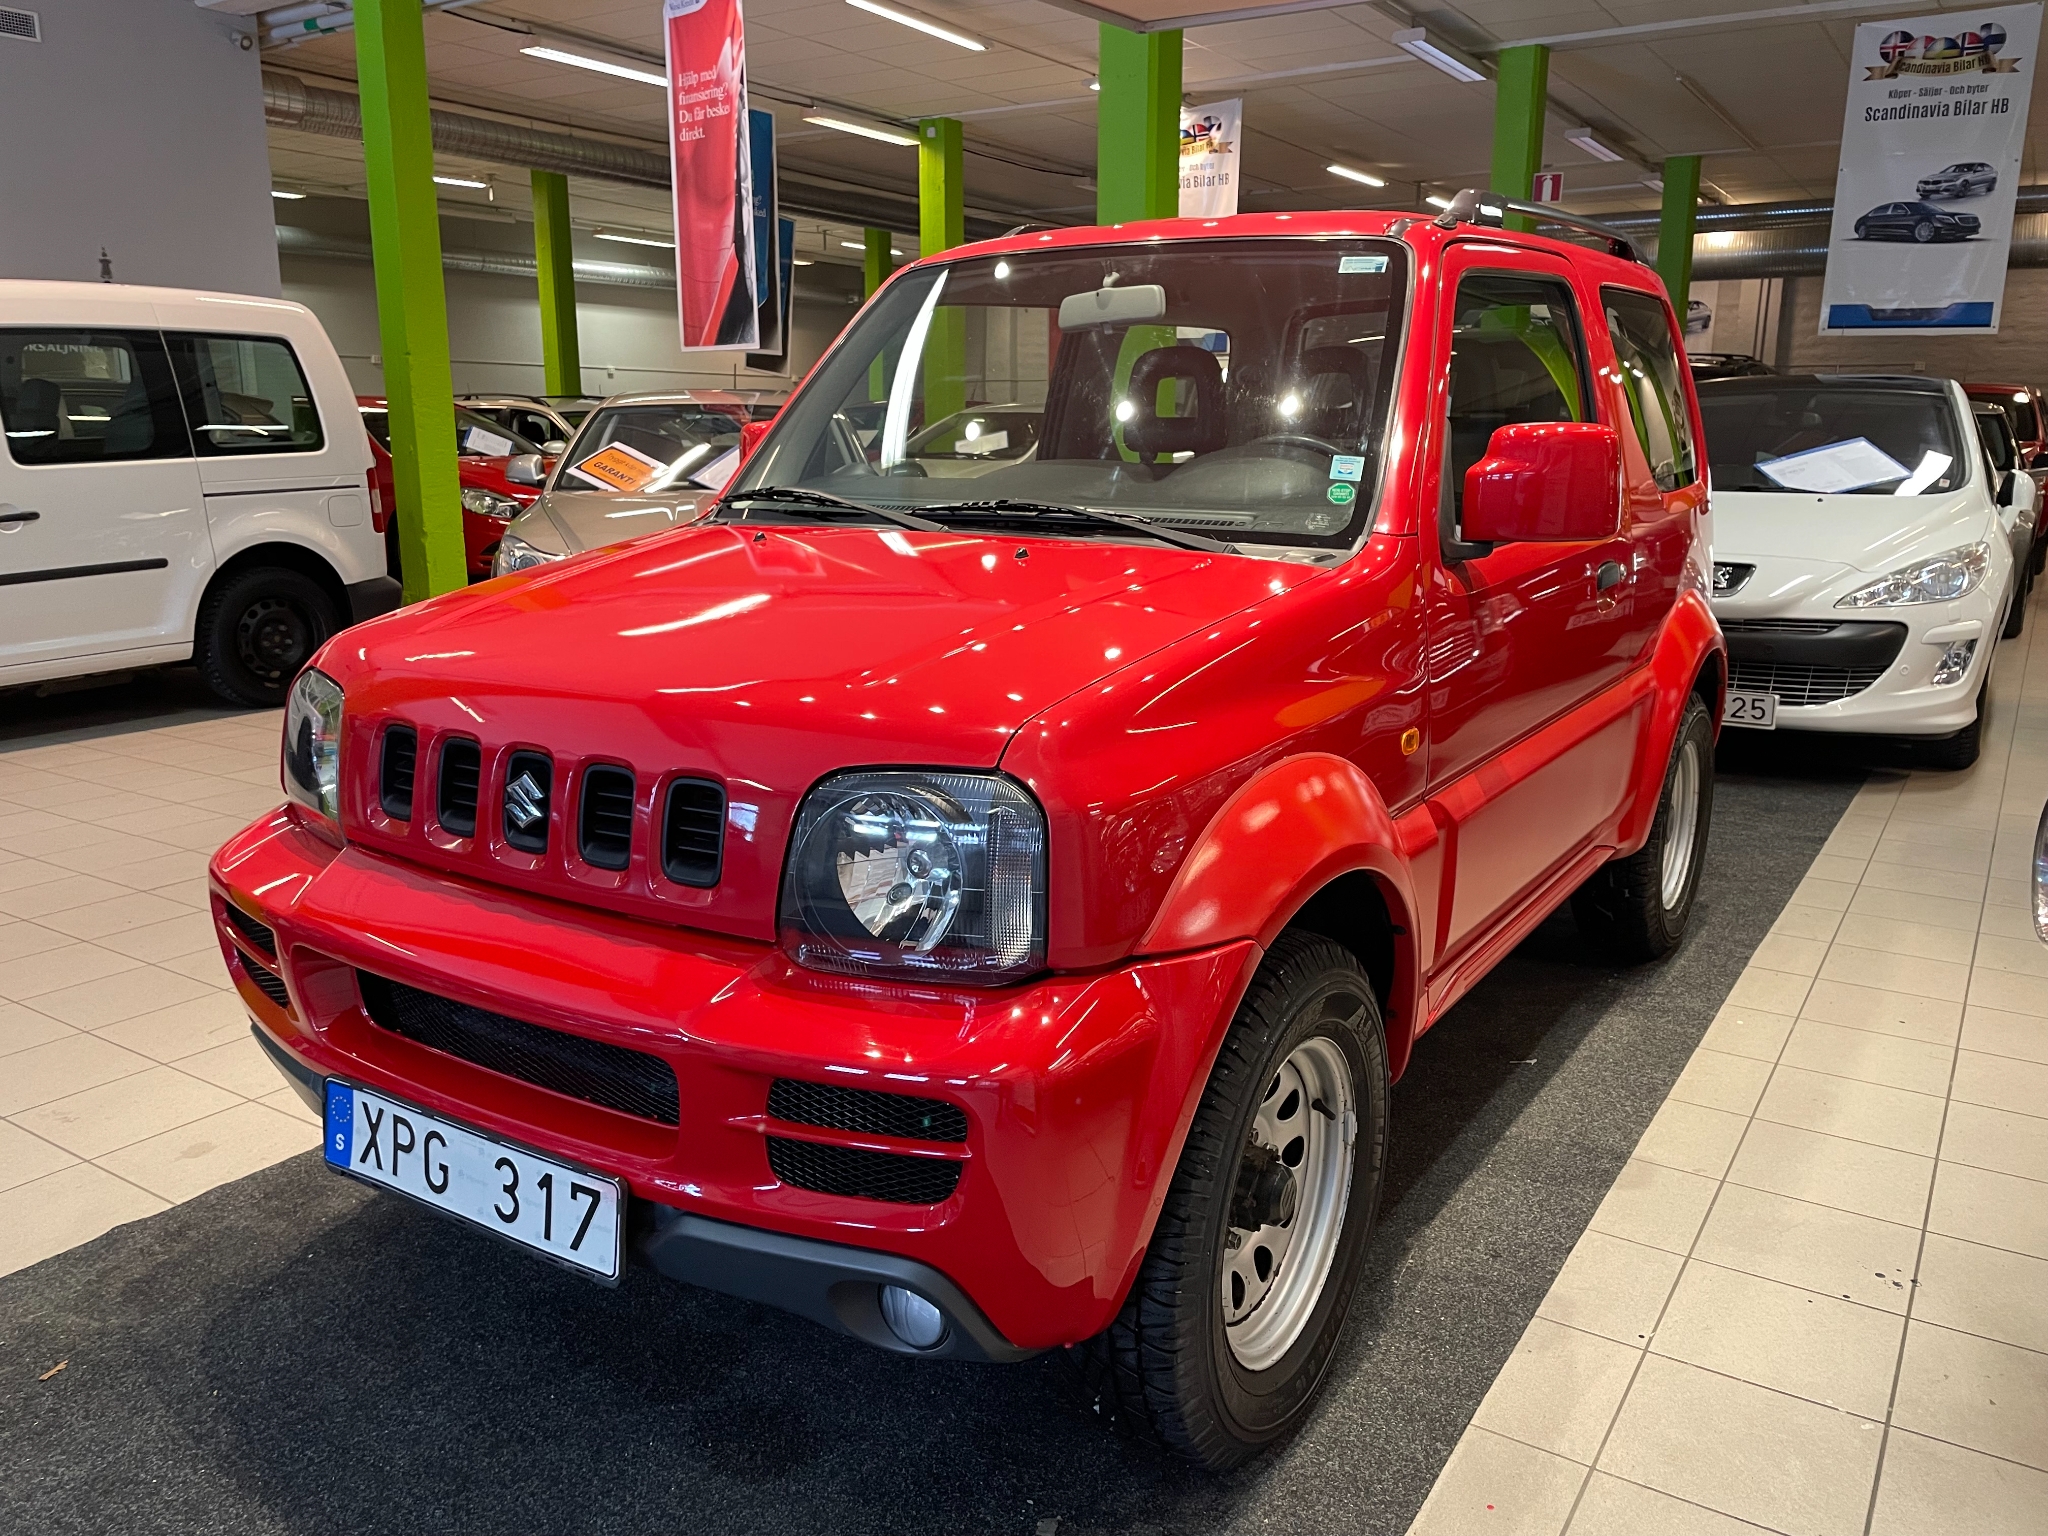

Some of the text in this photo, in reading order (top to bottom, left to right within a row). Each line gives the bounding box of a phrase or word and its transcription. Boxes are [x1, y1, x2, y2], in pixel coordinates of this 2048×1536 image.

[1953, 58, 1976, 73] Bilar
[678, 65, 717, 90] Hjälp med
[678, 82, 729, 106] finansiering?
[1888, 88, 1912, 99] Köper
[1918, 86, 1943, 98] Säljer
[1966, 83, 1990, 95] byter
[680, 110, 693, 123] Du
[706, 101, 731, 119] beske
[1865, 97, 2010, 122] Scandinavia Bilar HB
[1193, 173, 1216, 188] Bilar
[1218, 173, 1229, 185] HB
[594, 462, 636, 484] GARANTI
[1724, 696, 1766, 720] 25
[335, 1133, 345, 1151] S
[359, 1101, 602, 1252] XPG 317
